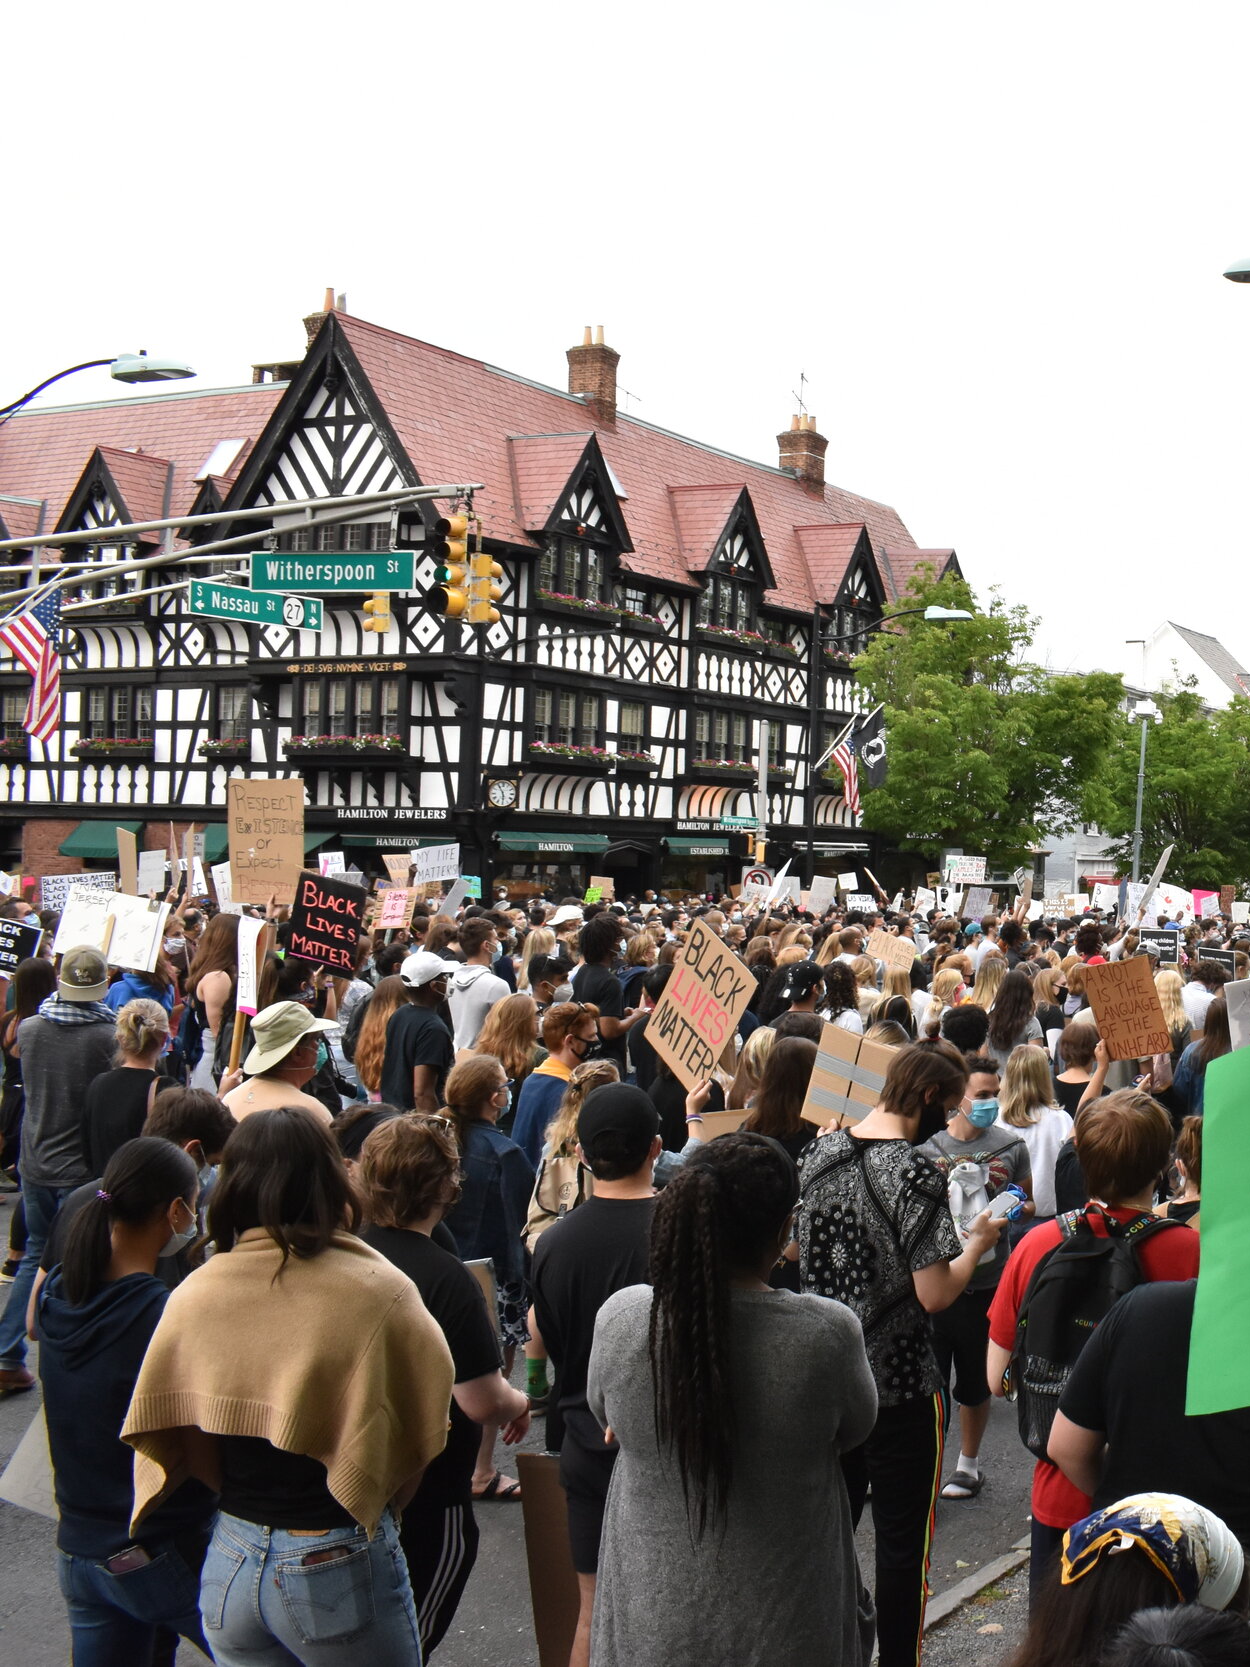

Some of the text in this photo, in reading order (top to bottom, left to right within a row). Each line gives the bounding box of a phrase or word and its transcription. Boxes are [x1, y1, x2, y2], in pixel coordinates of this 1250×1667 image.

[266, 559, 400, 585] Witherspoon St
[196, 585, 204, 597] S
[211, 590, 276, 615] Nassau St
[286, 603, 302, 620] 27
[337, 808, 447, 820] HAMILTON JEWELERS
[676, 821, 710, 831] HAMILTON
[256, 839, 272, 850] or
[376, 837, 420, 847] HAMILTON
[538, 842, 574, 852] HAMILTON
[690, 847, 724, 855] ESTABLISHED
[42, 873, 115, 886] BLACK LIVES MATTER
[71, 891, 118, 913] JERSEY
[684, 927, 747, 1015] BLACK
[1085, 960, 1134, 989] A RIOT
[1096, 978, 1149, 1004] IS THE
[670, 967, 729, 1046] LIVES
[1094, 996, 1160, 1023] LANGUAGE
[651, 998, 714, 1080] MATTER
[1099, 1015, 1153, 1040] OF THE
[1105, 1031, 1170, 1061] UNHEARD
